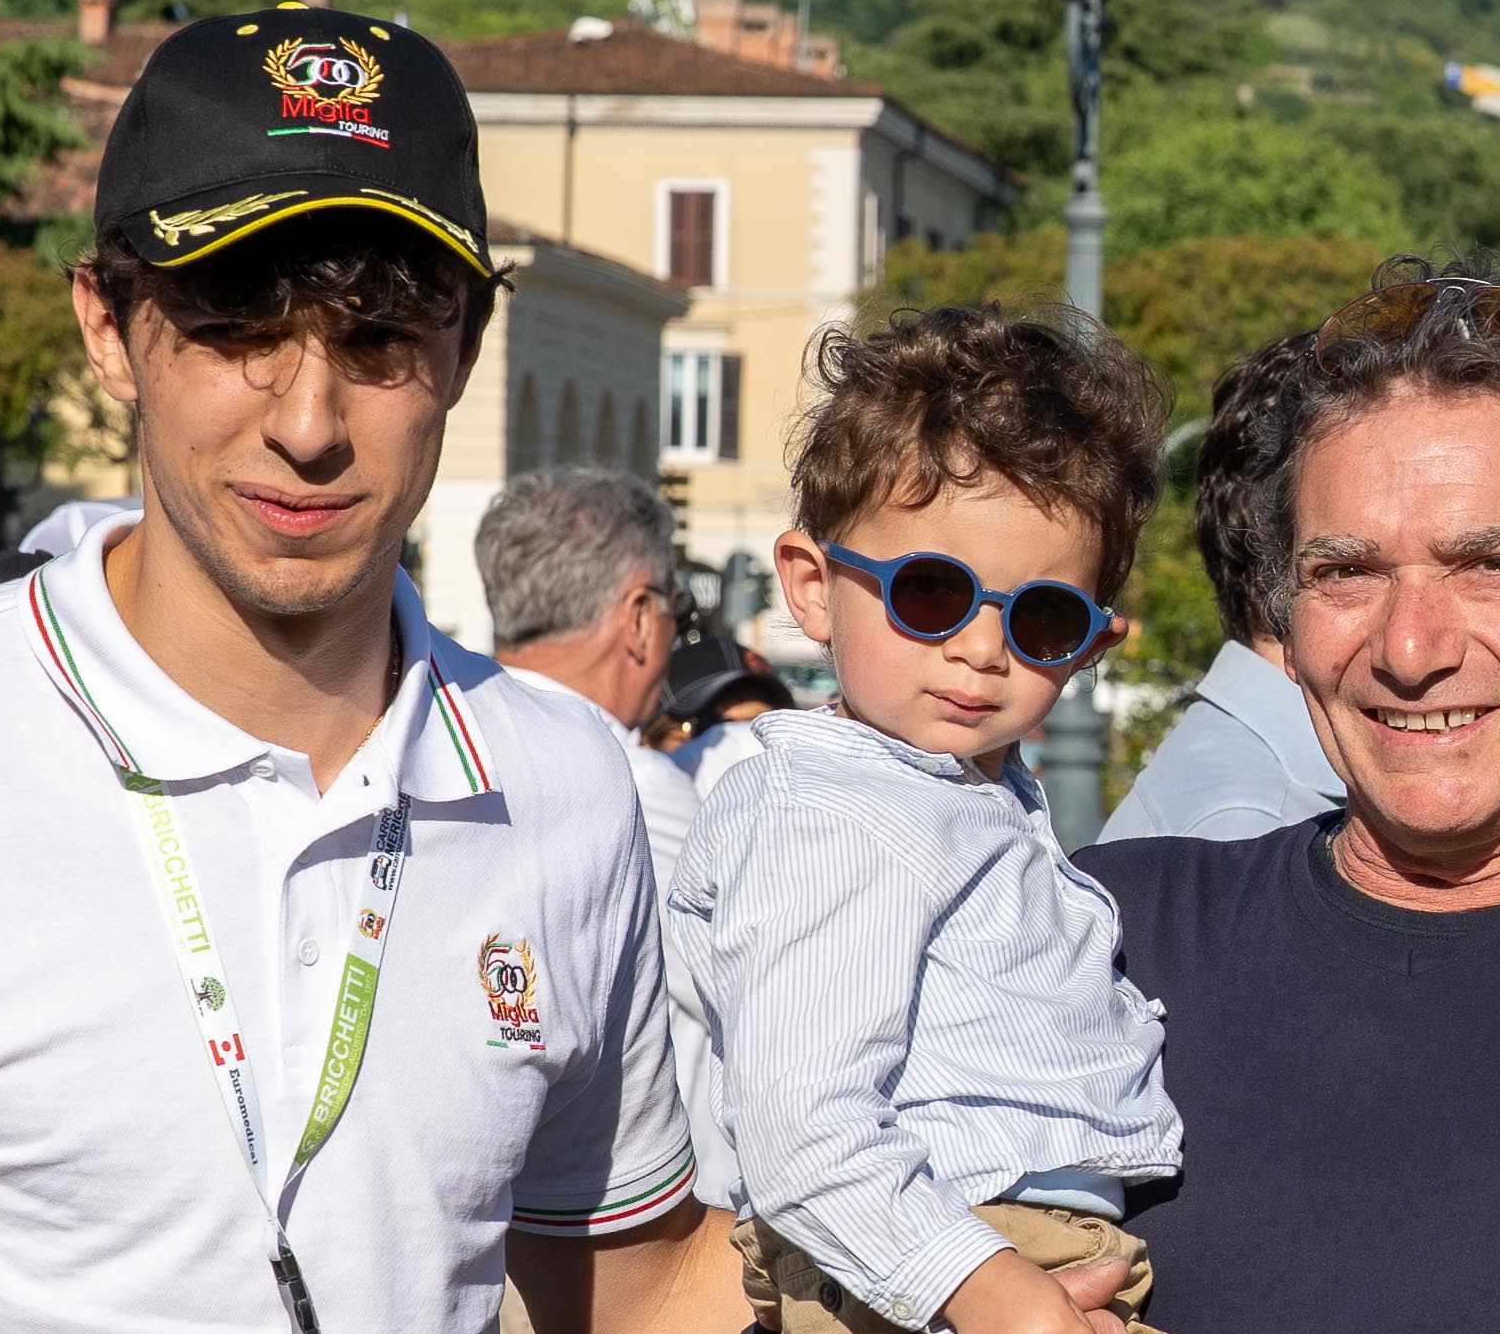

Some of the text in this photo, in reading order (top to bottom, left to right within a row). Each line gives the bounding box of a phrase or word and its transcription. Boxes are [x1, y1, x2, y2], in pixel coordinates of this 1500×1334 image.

[287, 42, 366, 88] 500
[281, 94, 372, 125] Miglia
[338, 120, 390, 142] TOURING
[376, 807, 393, 852] CARRO
[384, 792, 411, 857] MERIGHE
[142, 789, 211, 954] BRICCHETTI
[487, 1000, 540, 1028] Miglia
[499, 1026, 542, 1043] TOURING
[313, 963, 367, 1126] BRICCHETTI
[228, 1067, 259, 1166] Euromedical
